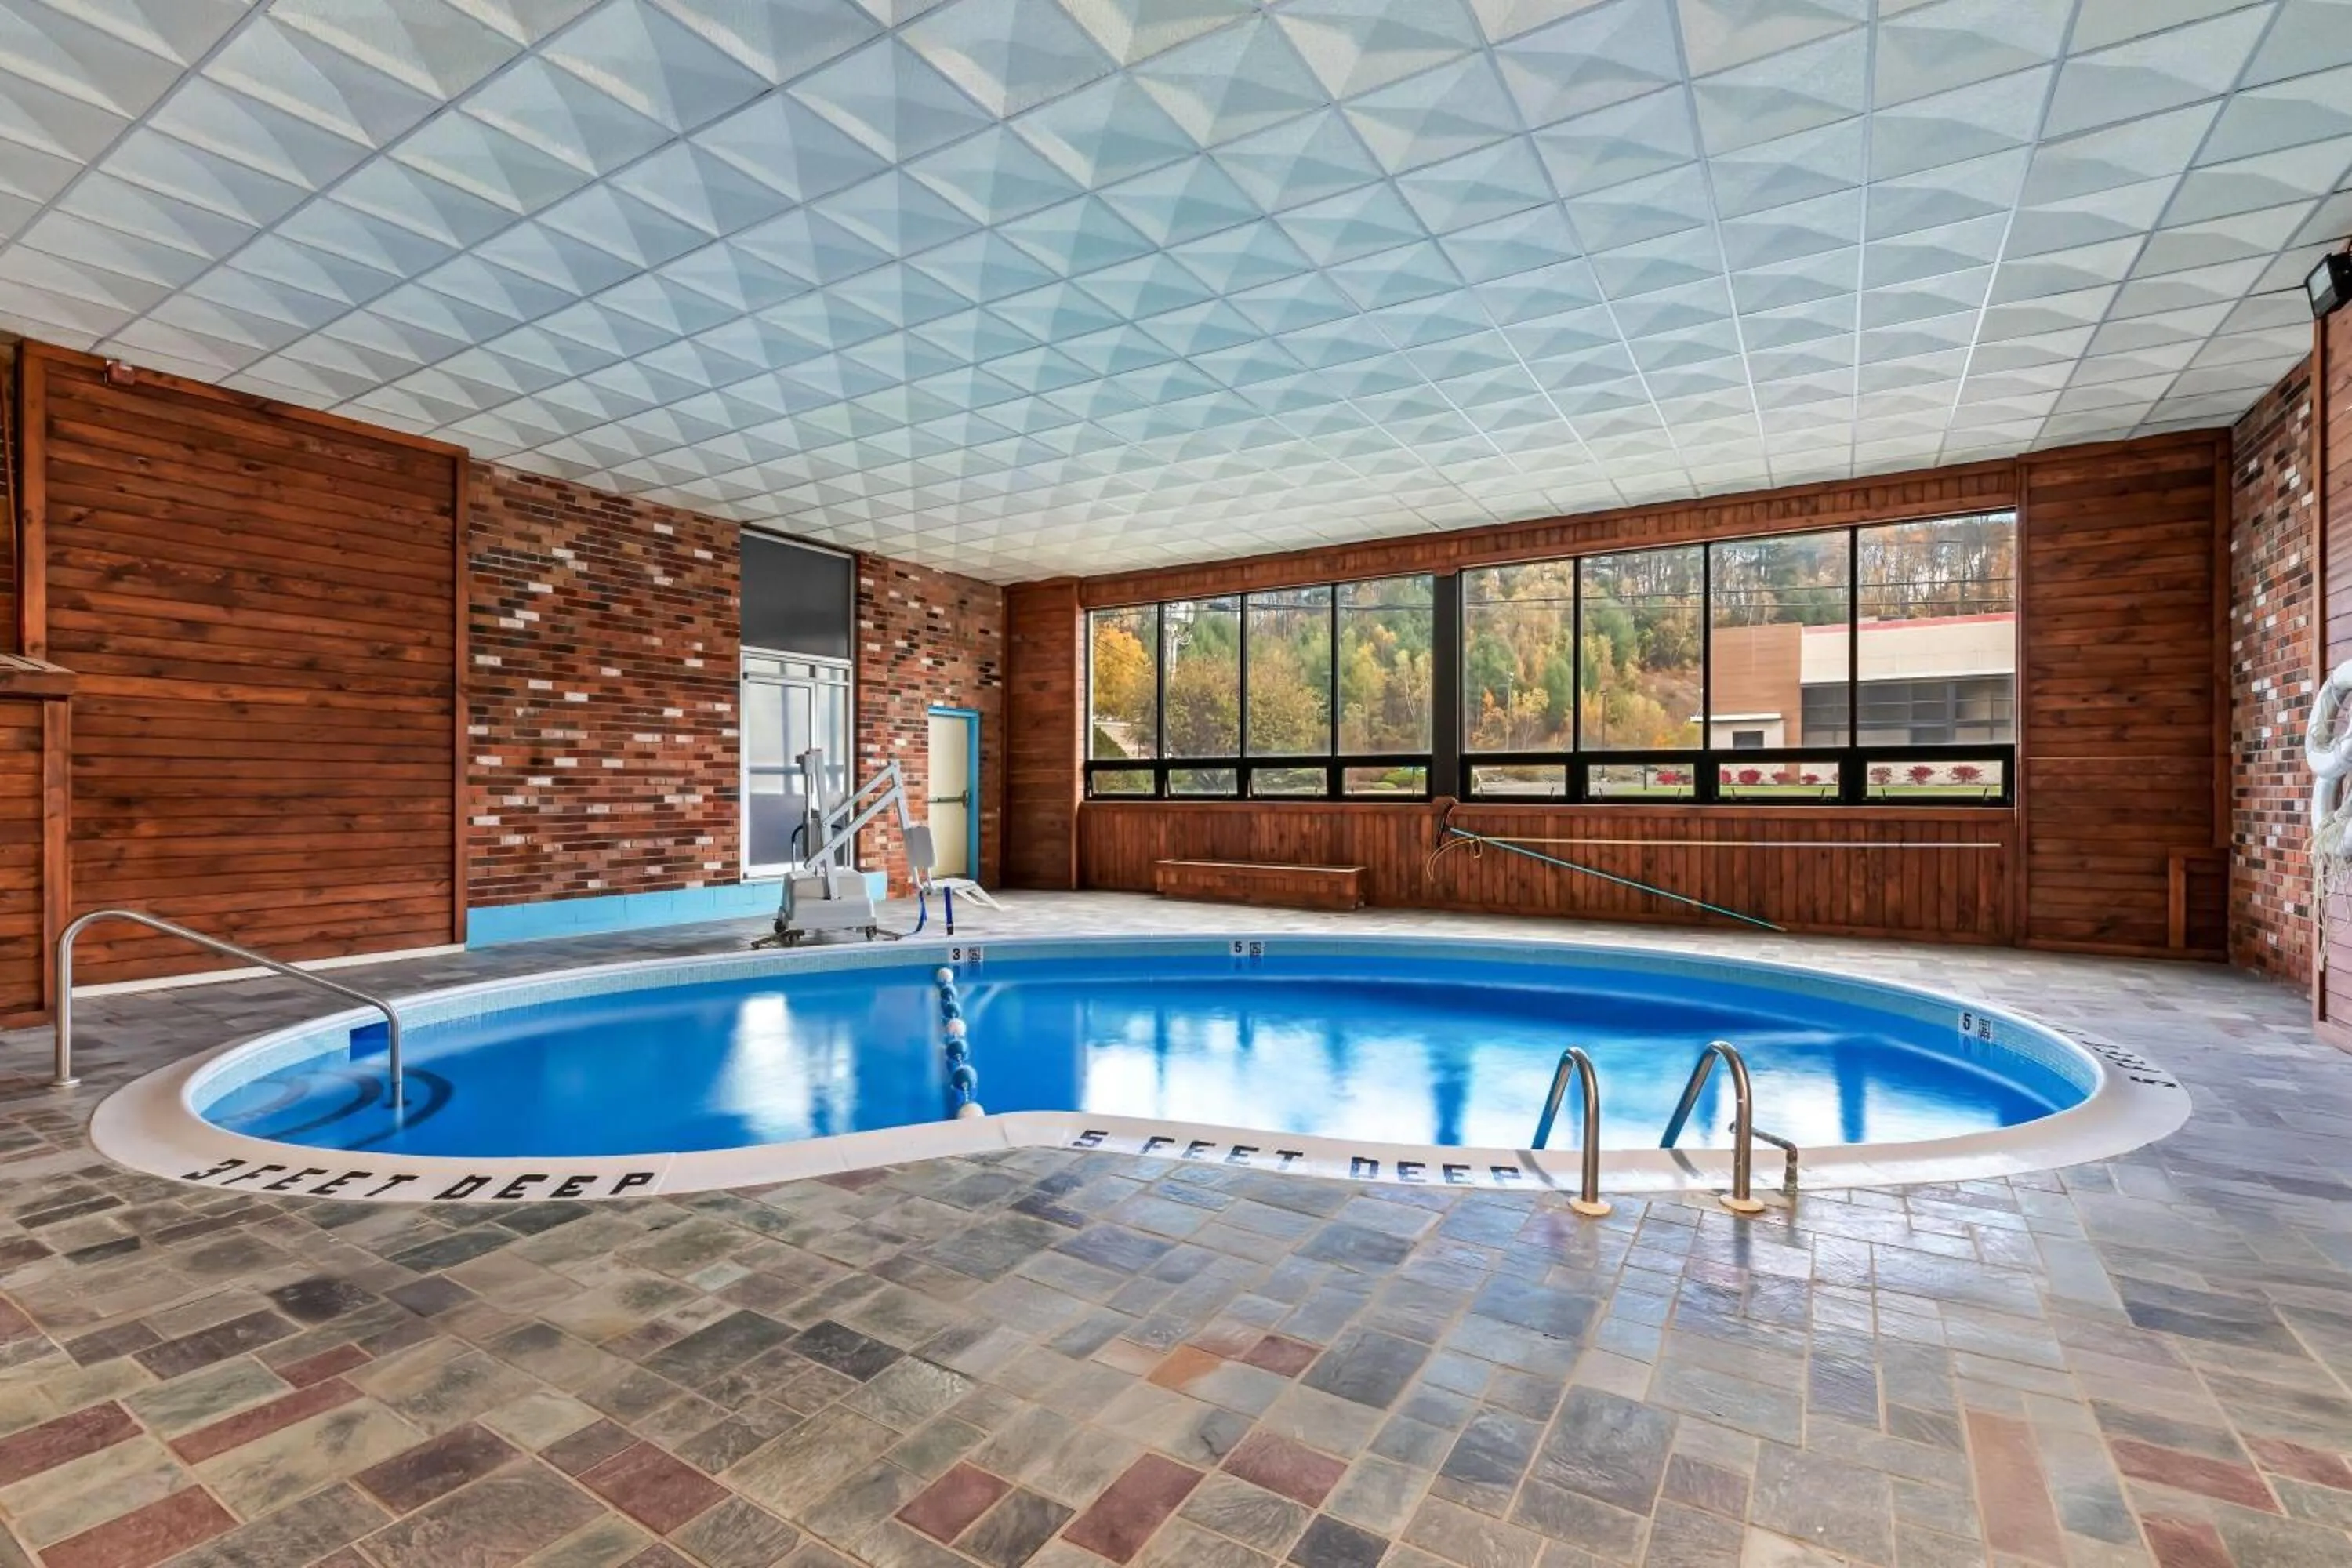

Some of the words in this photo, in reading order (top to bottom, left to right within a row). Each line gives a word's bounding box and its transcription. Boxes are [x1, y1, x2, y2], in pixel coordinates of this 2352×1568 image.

[952, 948, 960, 960] 3
[1234, 940, 1243, 954] 5
[1962, 1012, 1972, 1031] 5
[1072, 1130, 1109, 1148] 5
[1139, 1136, 1304, 1171] FEET
[1349, 1156, 1521, 1186] DEEP
[433, 1173, 655, 1200] DEEP
